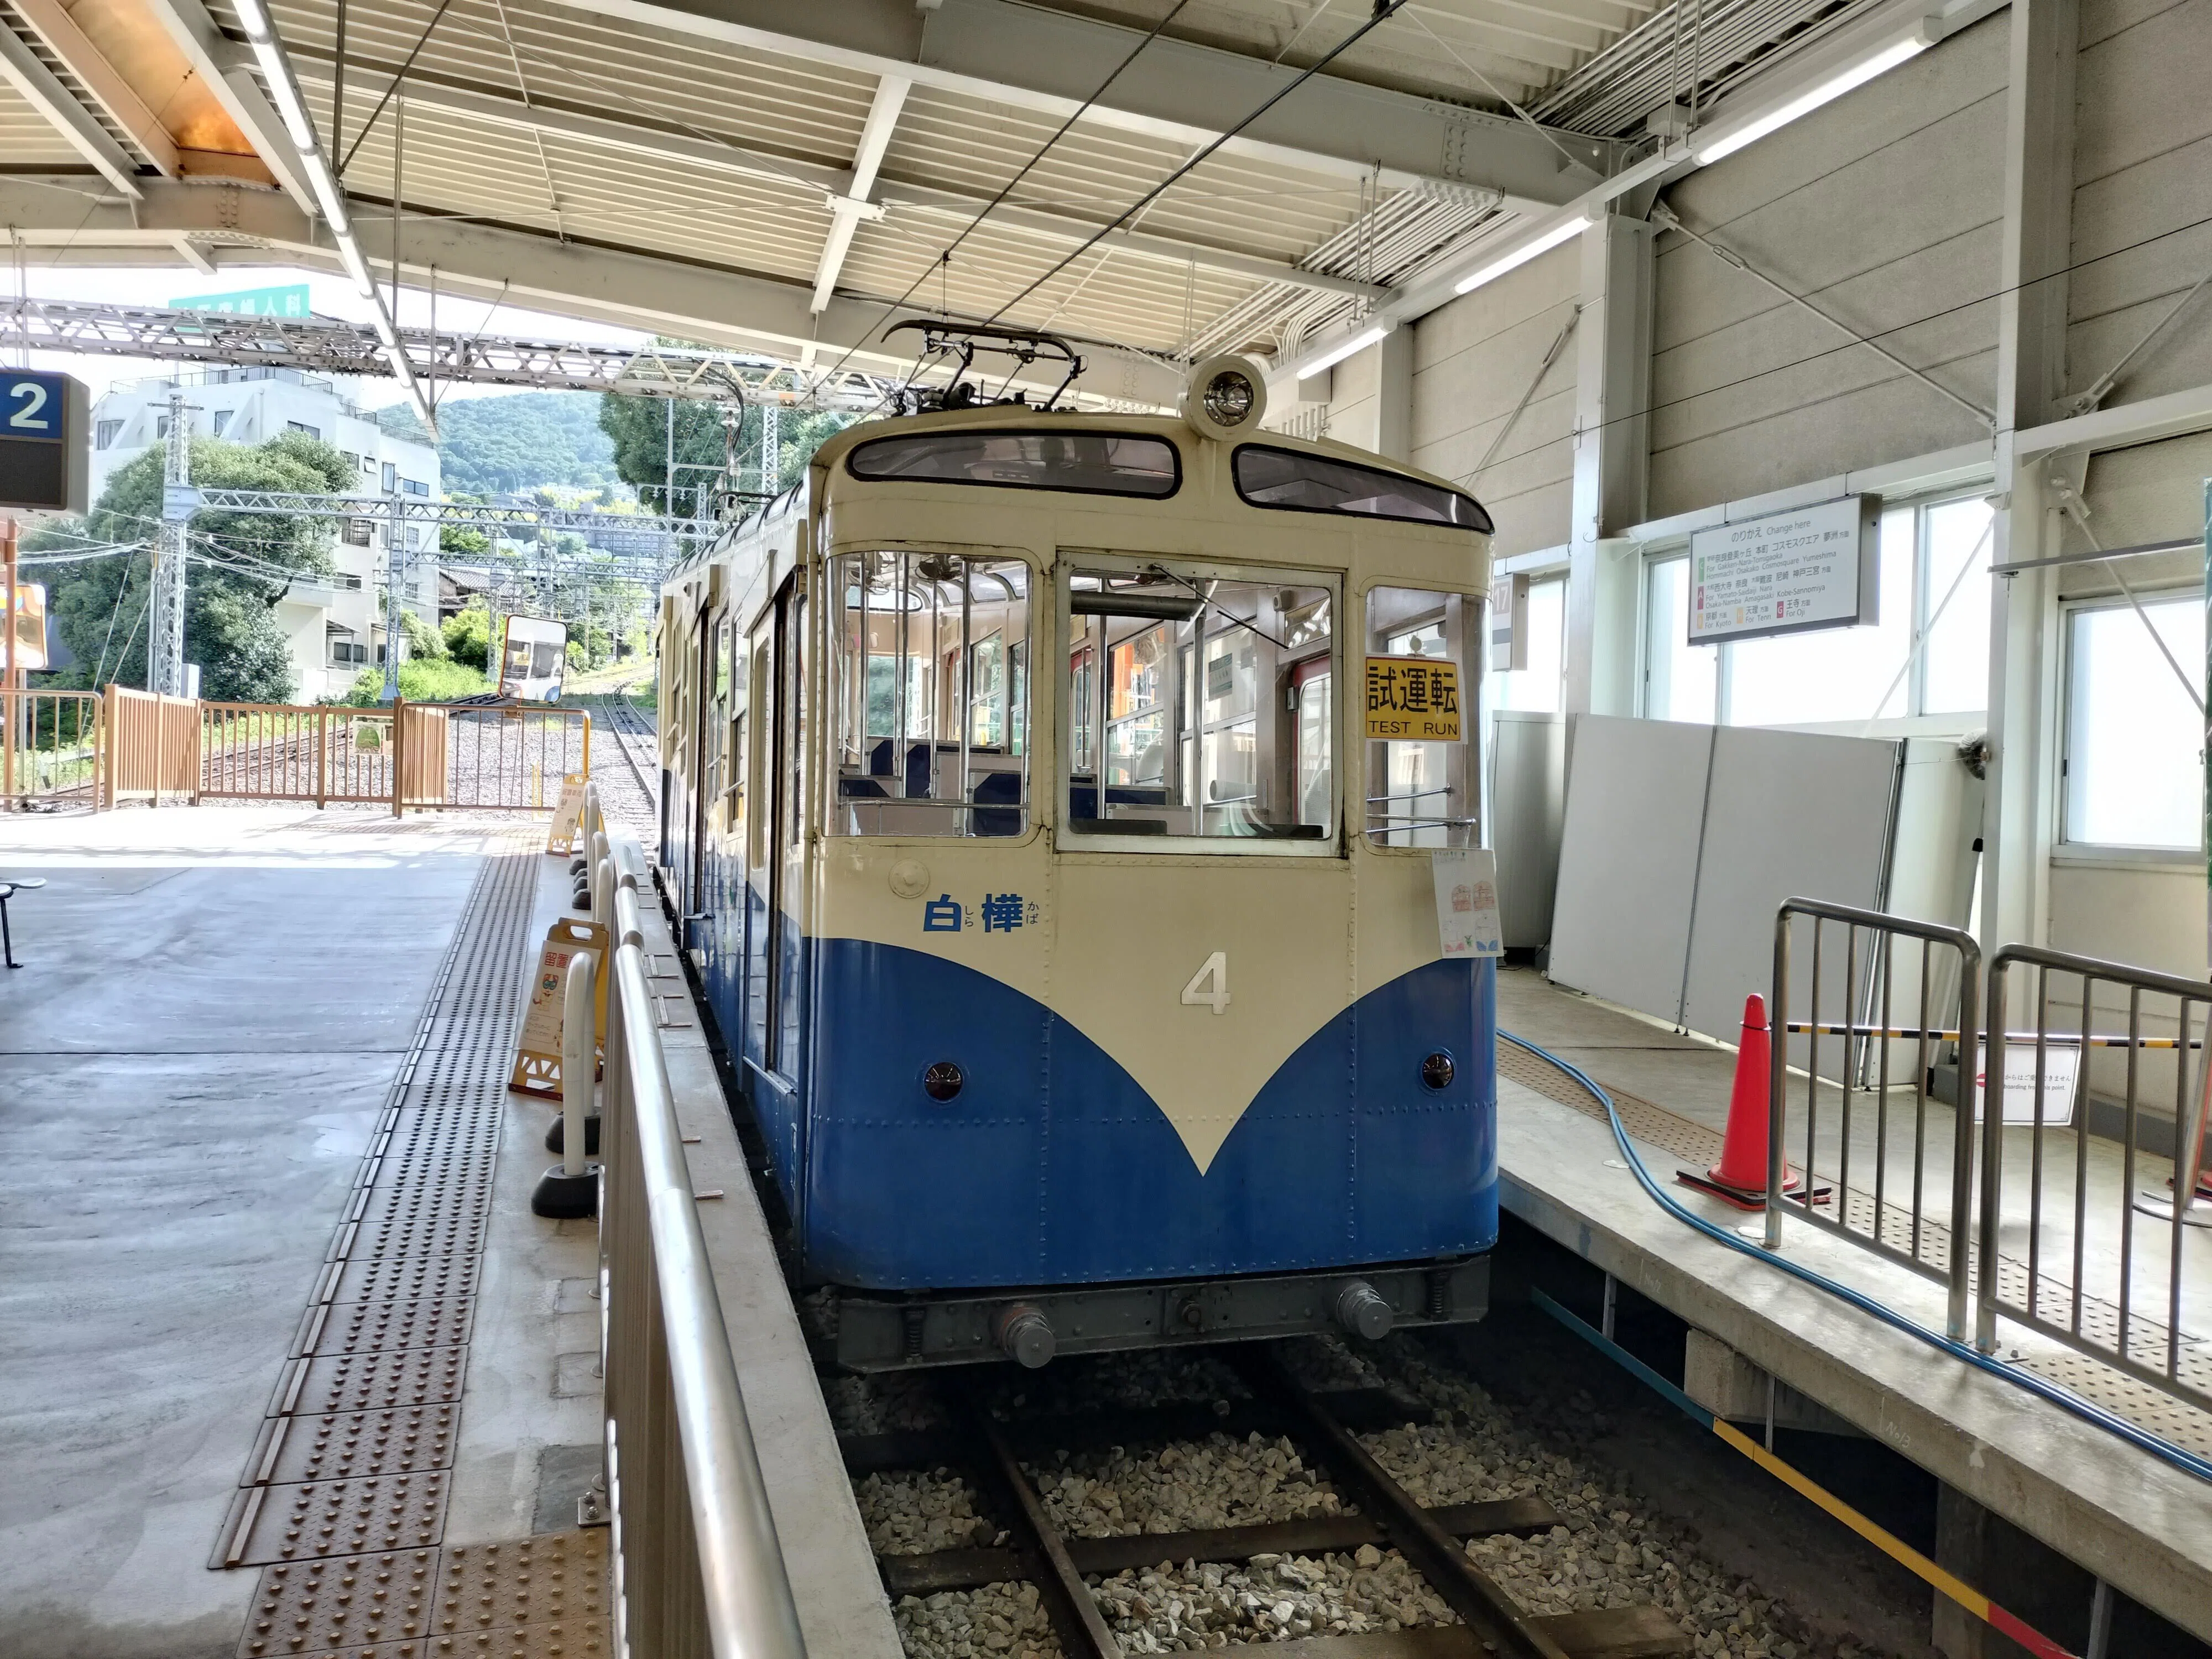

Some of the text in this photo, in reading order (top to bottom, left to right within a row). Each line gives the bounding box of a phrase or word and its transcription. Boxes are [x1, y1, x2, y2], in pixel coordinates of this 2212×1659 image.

[10, 382, 49, 429] 2
[1731, 527, 1762, 542] のりかえ
[1766, 520, 1811, 535] Change here
[1756, 545, 1768, 554] 本町
[1772, 534, 1819, 551] コスモスクエア
[1707, 551, 1837, 580] Hommachi Osakako Cosmosquare Yumeshima
[1718, 553, 1783, 570] Gakken-Nara-Tomigaoka
[1735, 578, 1748, 588] 奈良
[1776, 571, 1789, 581] 尼崎
[1793, 566, 1819, 578] 神戸三宮
[1494, 586, 1509, 611] 17
[1698, 591, 1703, 599] A
[1706, 585, 1825, 609] Osaka-Namba Amagasaki Kobe-Sannomiya
[1717, 588, 1756, 599] Yamato-Saidaiji
[1786, 598, 1799, 609] 王寺
[1797, 609, 1805, 617] Oji
[1715, 620, 1731, 628] Kyoto
[1368, 666, 1458, 714] 試運転
[1369, 721, 1458, 735] TEST RUN
[923, 893, 1023, 933] 白樺
[964, 905, 974, 927] しら
[1026, 901, 1039, 925] かば
[545, 952, 573, 968] 留置
[1180, 951, 1231, 1015] 4
